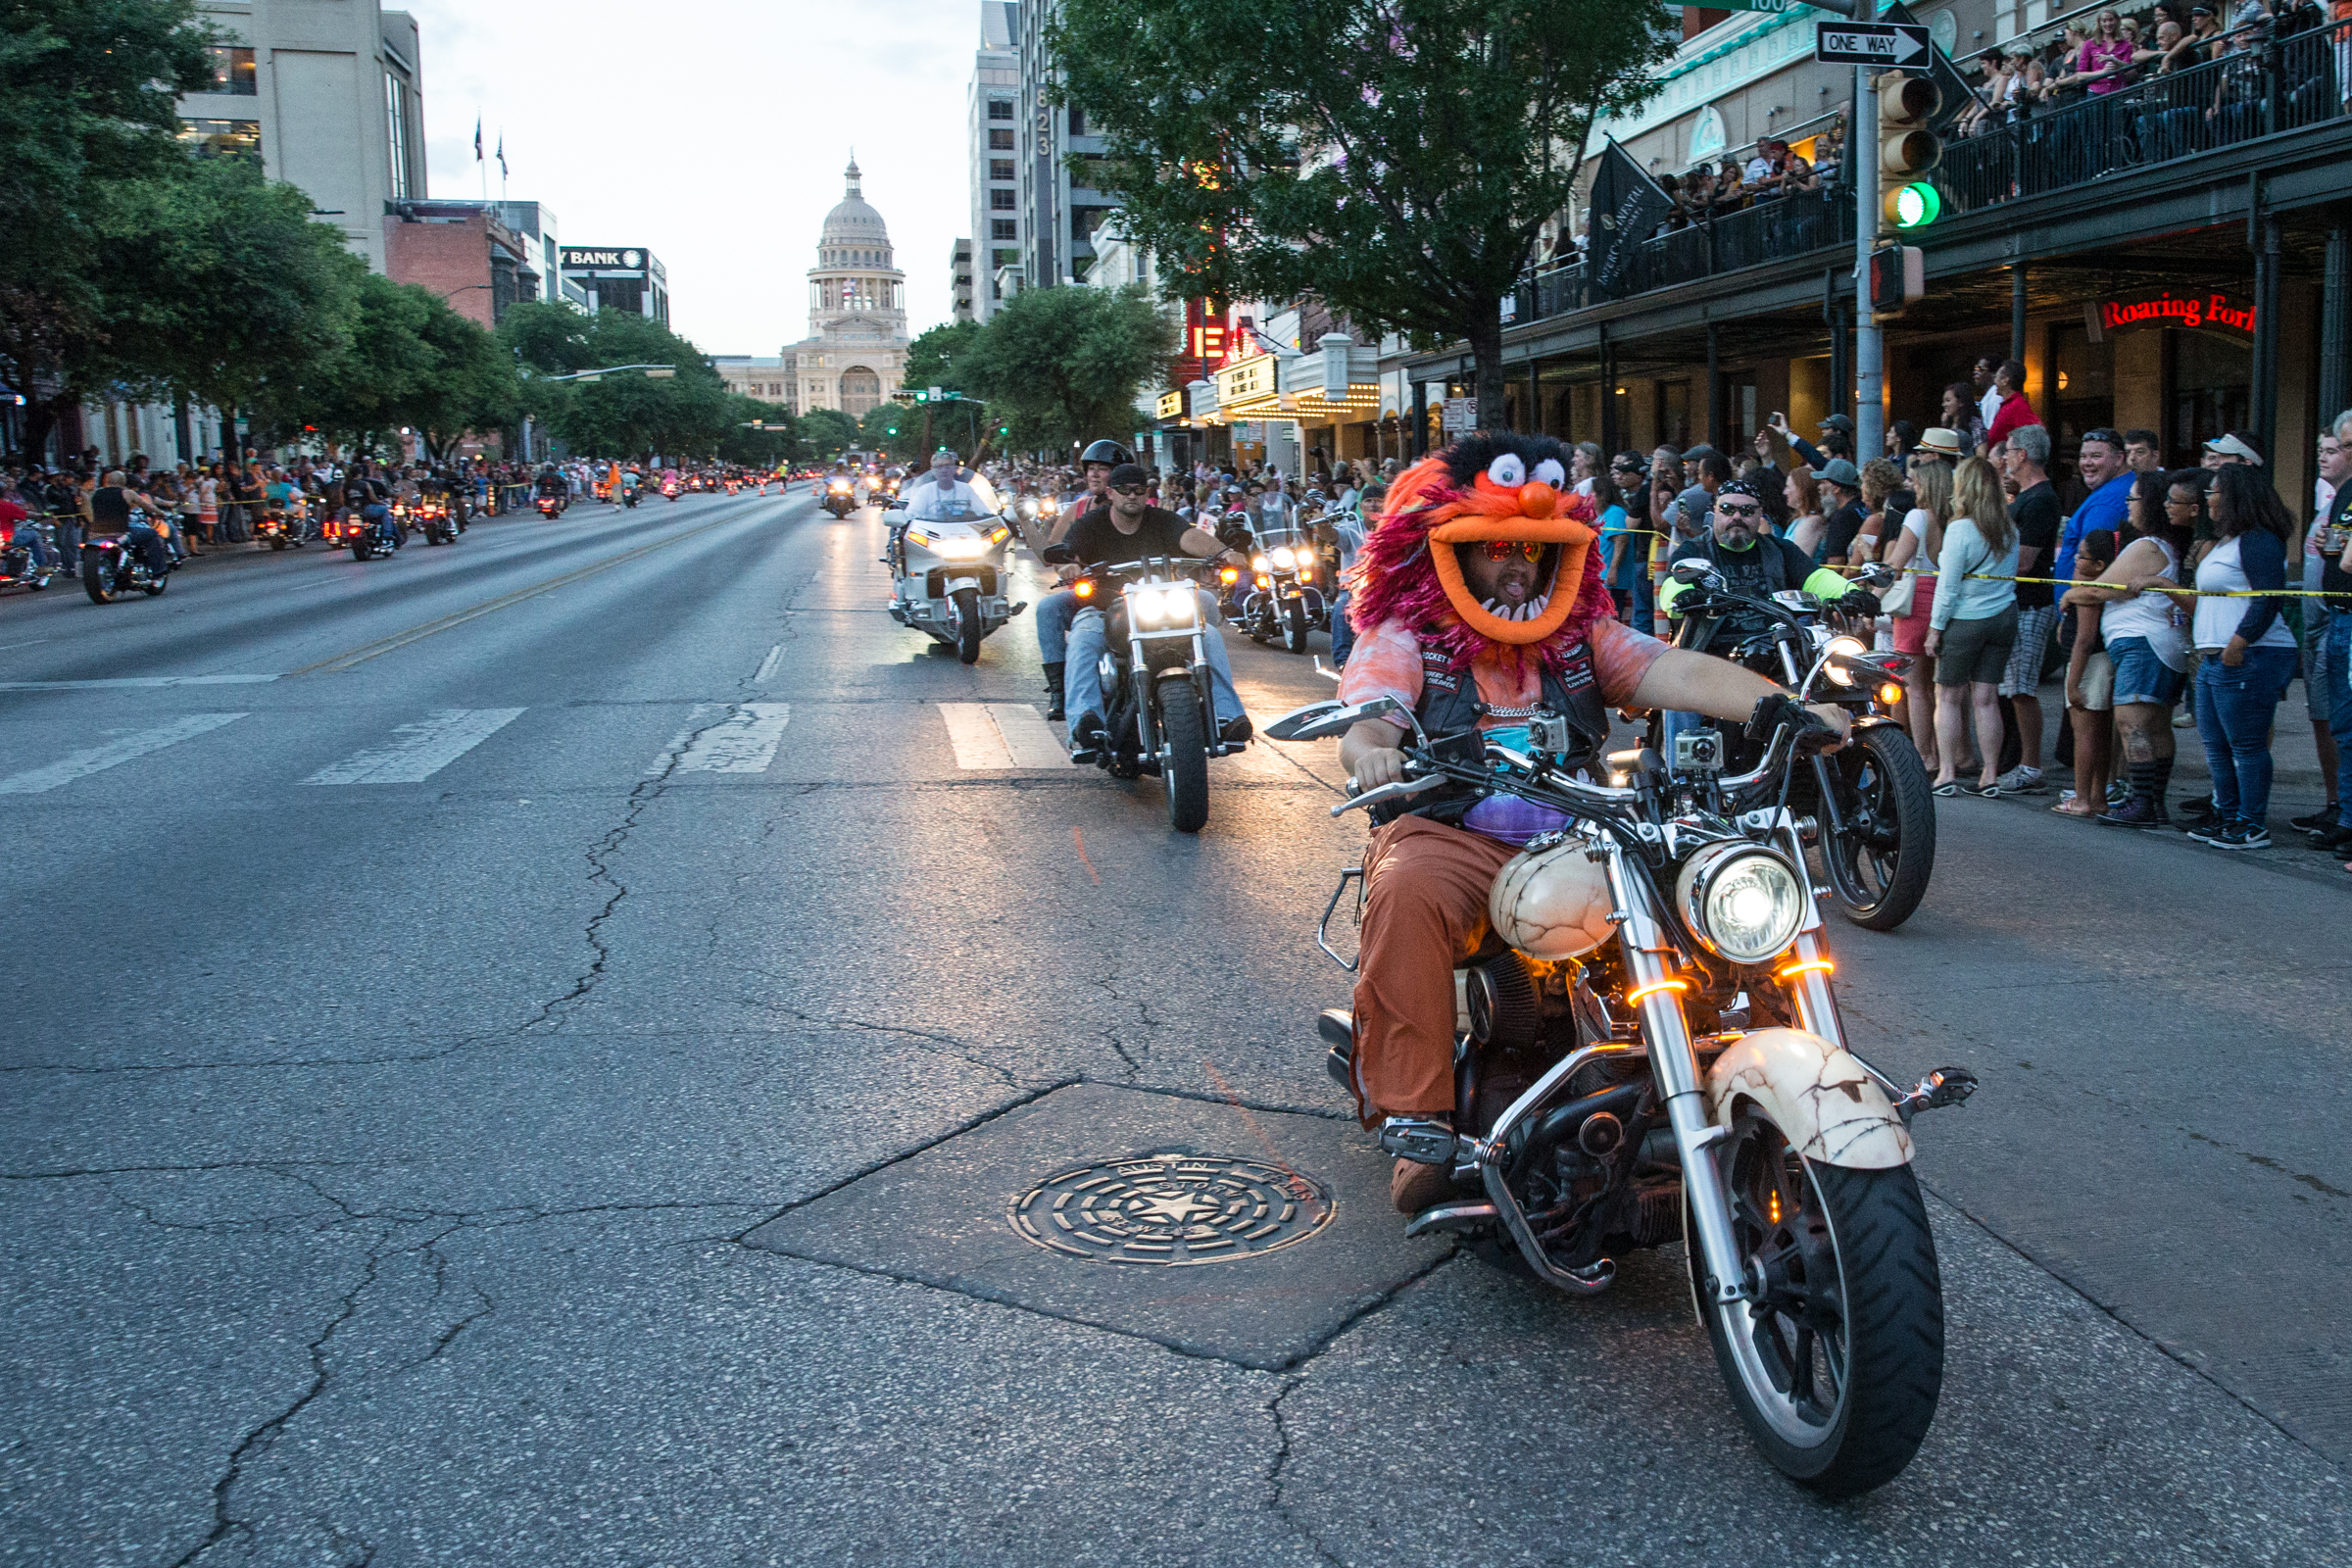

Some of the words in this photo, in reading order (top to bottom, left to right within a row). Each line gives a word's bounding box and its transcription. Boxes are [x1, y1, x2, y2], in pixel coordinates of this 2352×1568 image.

[1829, 33, 1858, 52] ONE
[1866, 36, 1897, 54] WAY
[1036, 88, 1051, 156] 823
[569, 252, 620, 265] BANK
[2103, 291, 2201, 329] Roaring
[1116, 1161, 1209, 1176] AUSTIN
[1158, 1181, 1243, 1200] STORM
